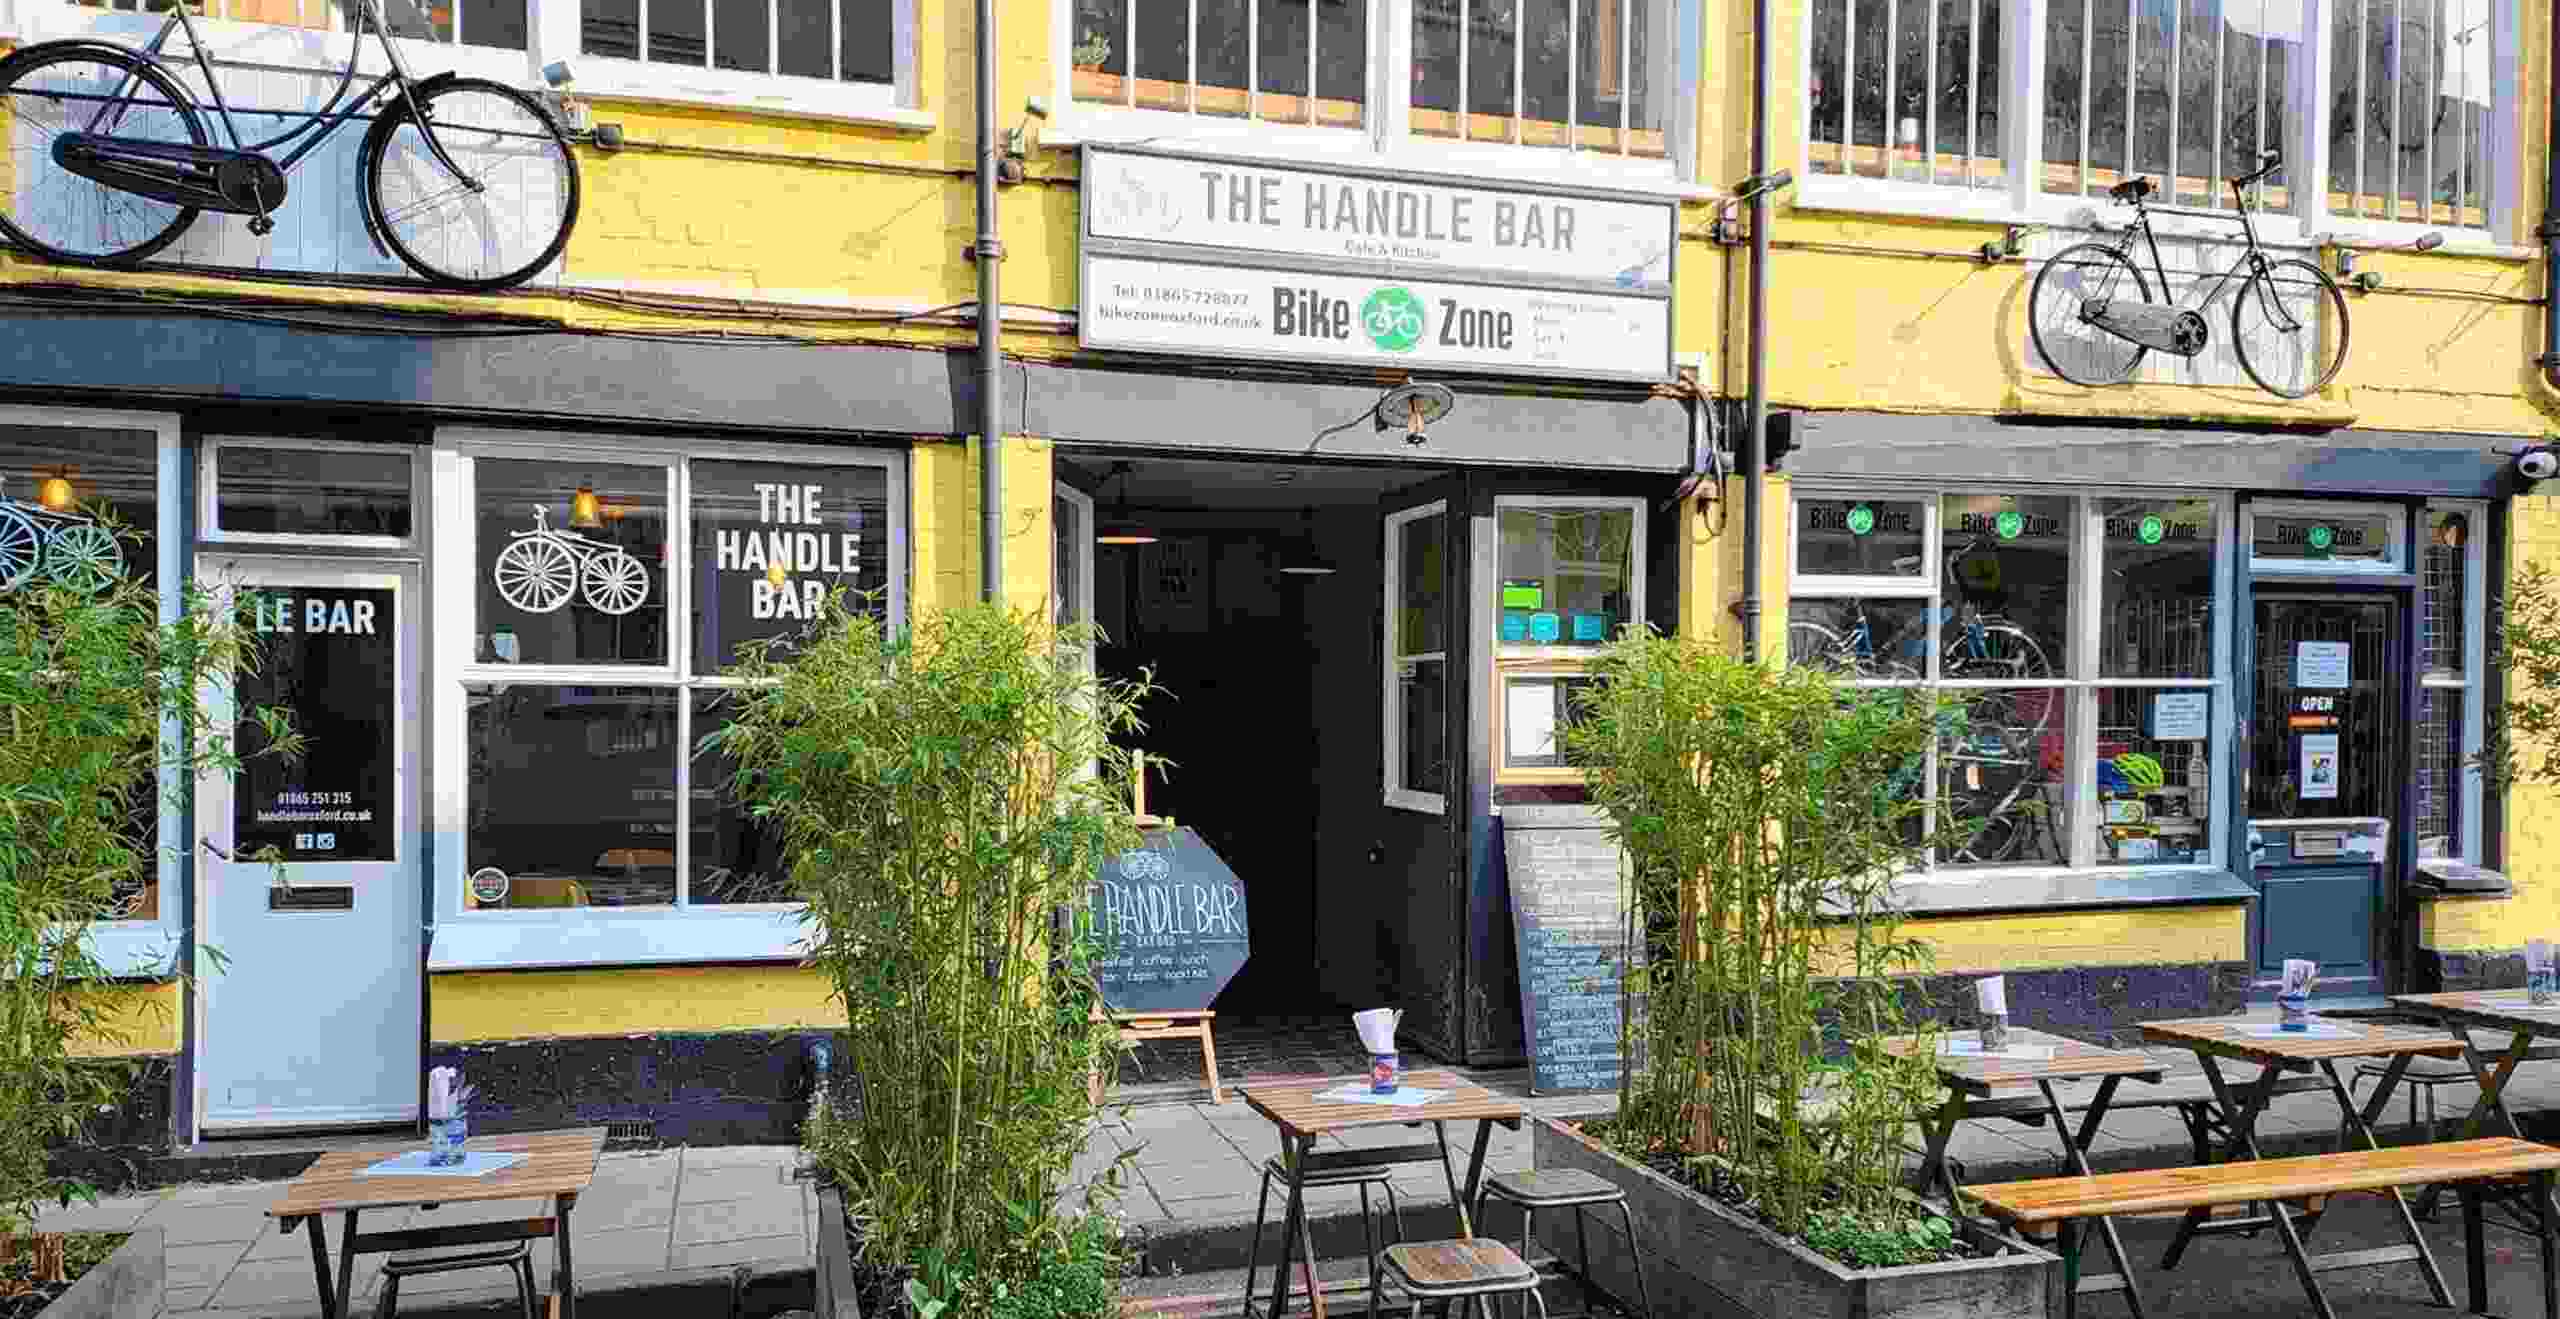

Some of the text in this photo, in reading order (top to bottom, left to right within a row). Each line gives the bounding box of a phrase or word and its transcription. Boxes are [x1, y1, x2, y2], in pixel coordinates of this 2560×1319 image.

[1199, 171, 1577, 252] THE HANDLE BAR
[1273, 286, 1513, 350] Bike Zone
[753, 482, 823, 524] THE
[1809, 506, 1912, 530] Bike Zone
[1960, 511, 2058, 536] Bike Zone
[2105, 518, 2199, 539] Bike Zone
[2278, 524, 2364, 545] Bike Zone
[716, 530, 861, 573] HANDLE
[752, 578, 826, 619] BAR
[304, 599, 376, 634] BAR
[2302, 696, 2334, 711] OPEN
[311, 792, 329, 804] 251
[332, 792, 352, 804] 315
[1104, 880, 1192, 935] HANDLE
[1193, 882, 1243, 935] BAR
